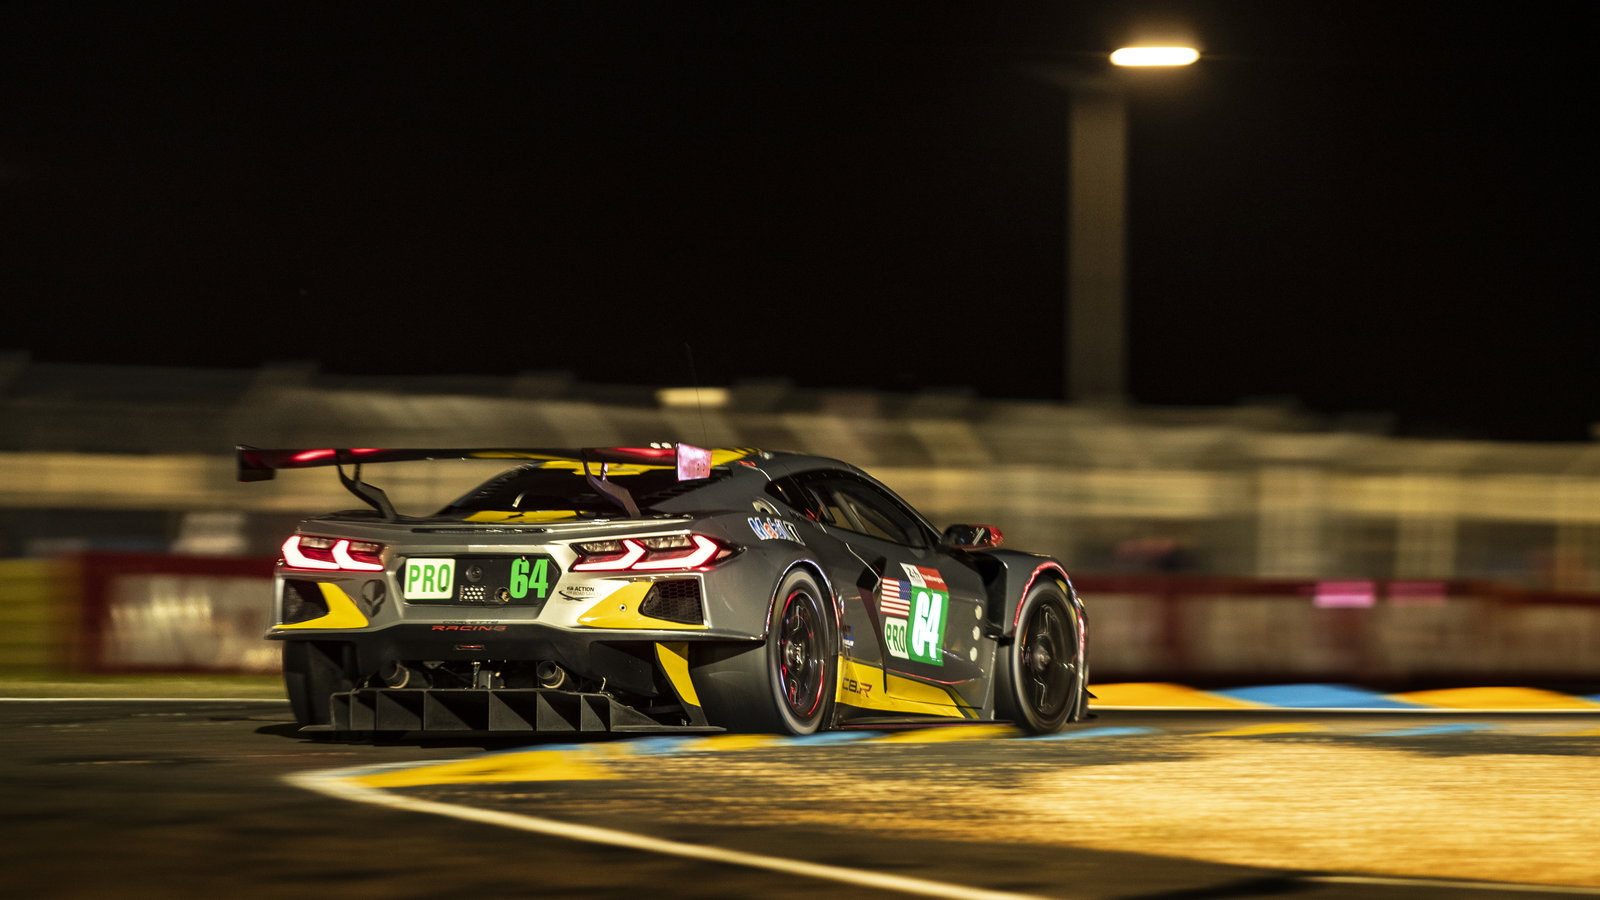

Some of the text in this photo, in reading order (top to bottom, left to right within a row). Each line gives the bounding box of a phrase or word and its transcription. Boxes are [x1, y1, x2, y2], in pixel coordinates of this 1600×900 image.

[748, 517, 793, 541] Mobil
[408, 564, 450, 593] PRO
[510, 558, 548, 599] 64
[886, 623, 905, 653] PRO
[912, 591, 942, 659] 64
